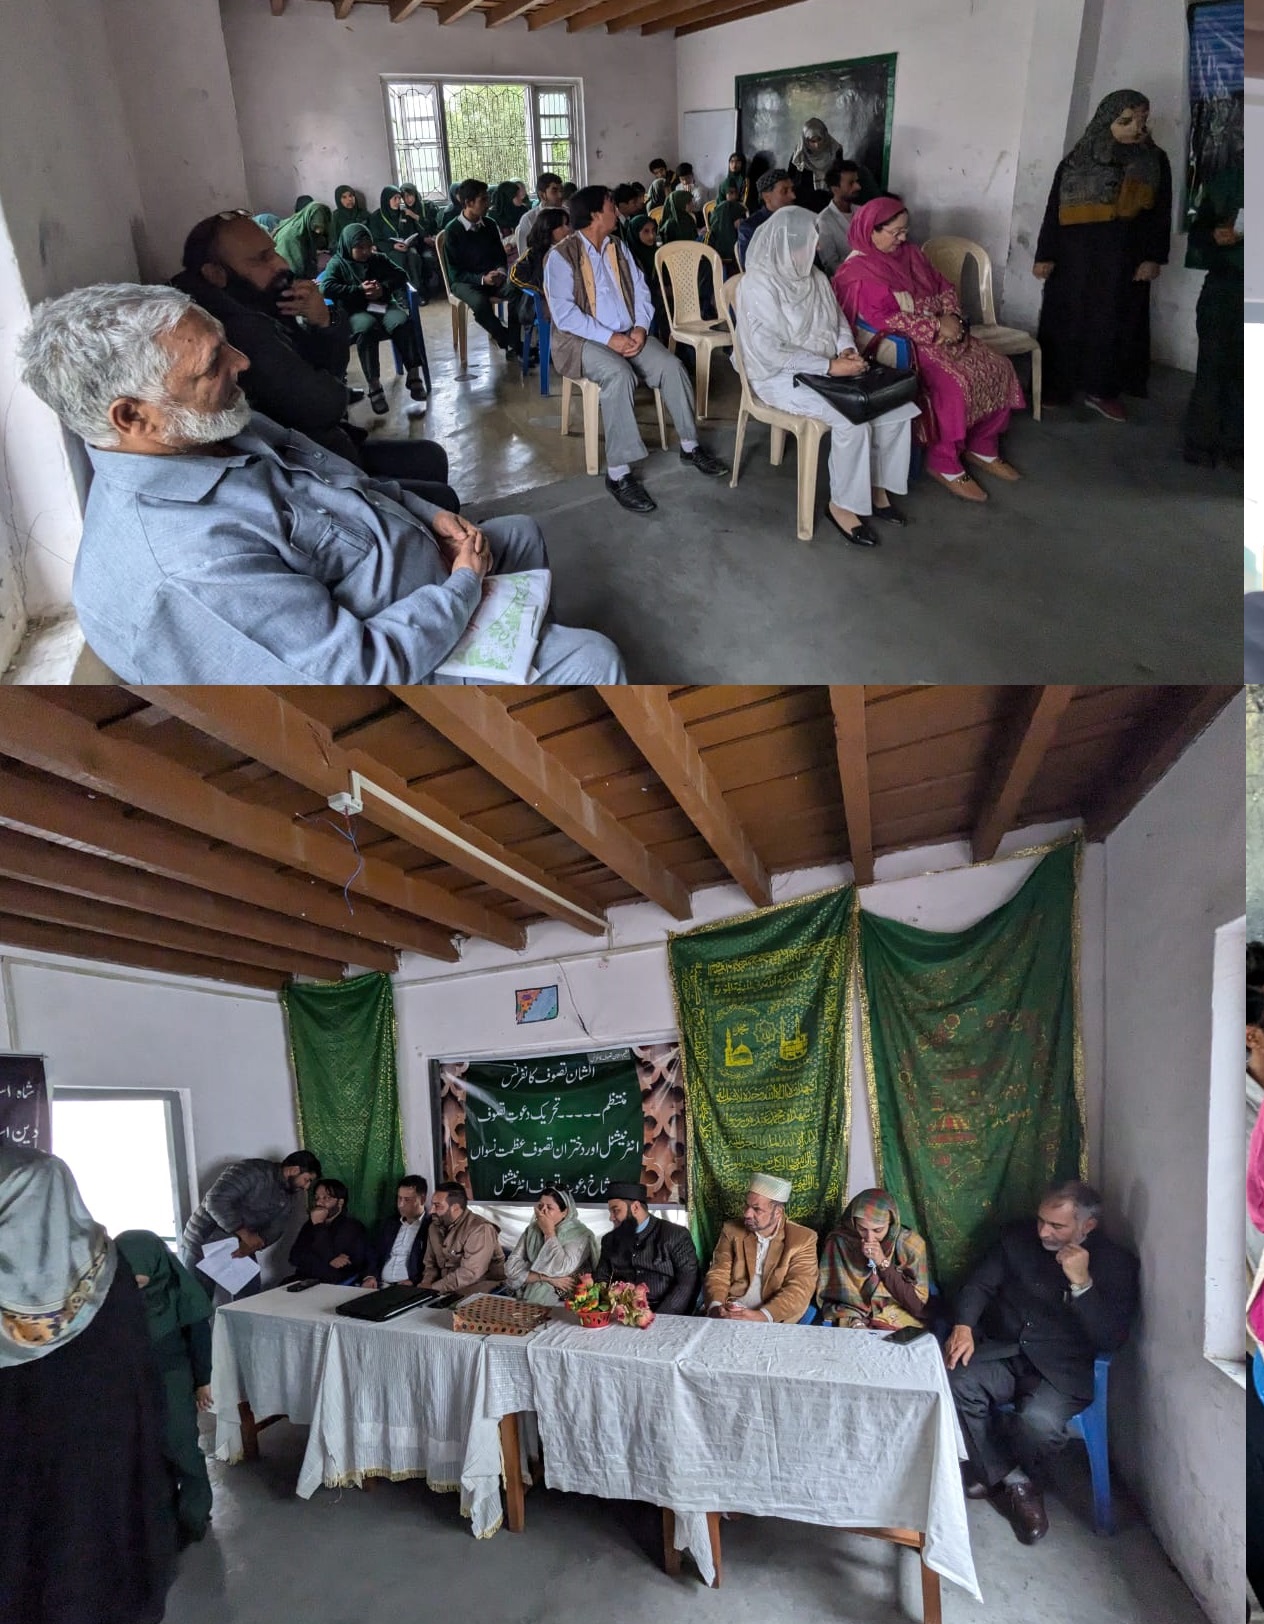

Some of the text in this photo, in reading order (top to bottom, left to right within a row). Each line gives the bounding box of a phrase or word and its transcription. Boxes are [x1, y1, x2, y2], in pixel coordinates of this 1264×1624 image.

[501, 1062, 595, 1090] الشان تصوف کانفرنس
[477, 1102, 506, 1123] تصوف
[530, 1097, 560, 1124] تحریک
[602, 1092, 627, 1124] منتظم
[470, 1138, 497, 1160] نسواں
[495, 1138, 526, 1157] عظمت
[522, 1136, 554, 1157] تصوف
[584, 1141, 599, 1156] اور
[599, 1129, 639, 1161] انٹرنیشنل
[494, 1169, 529, 1198] انٹرنیشنل
